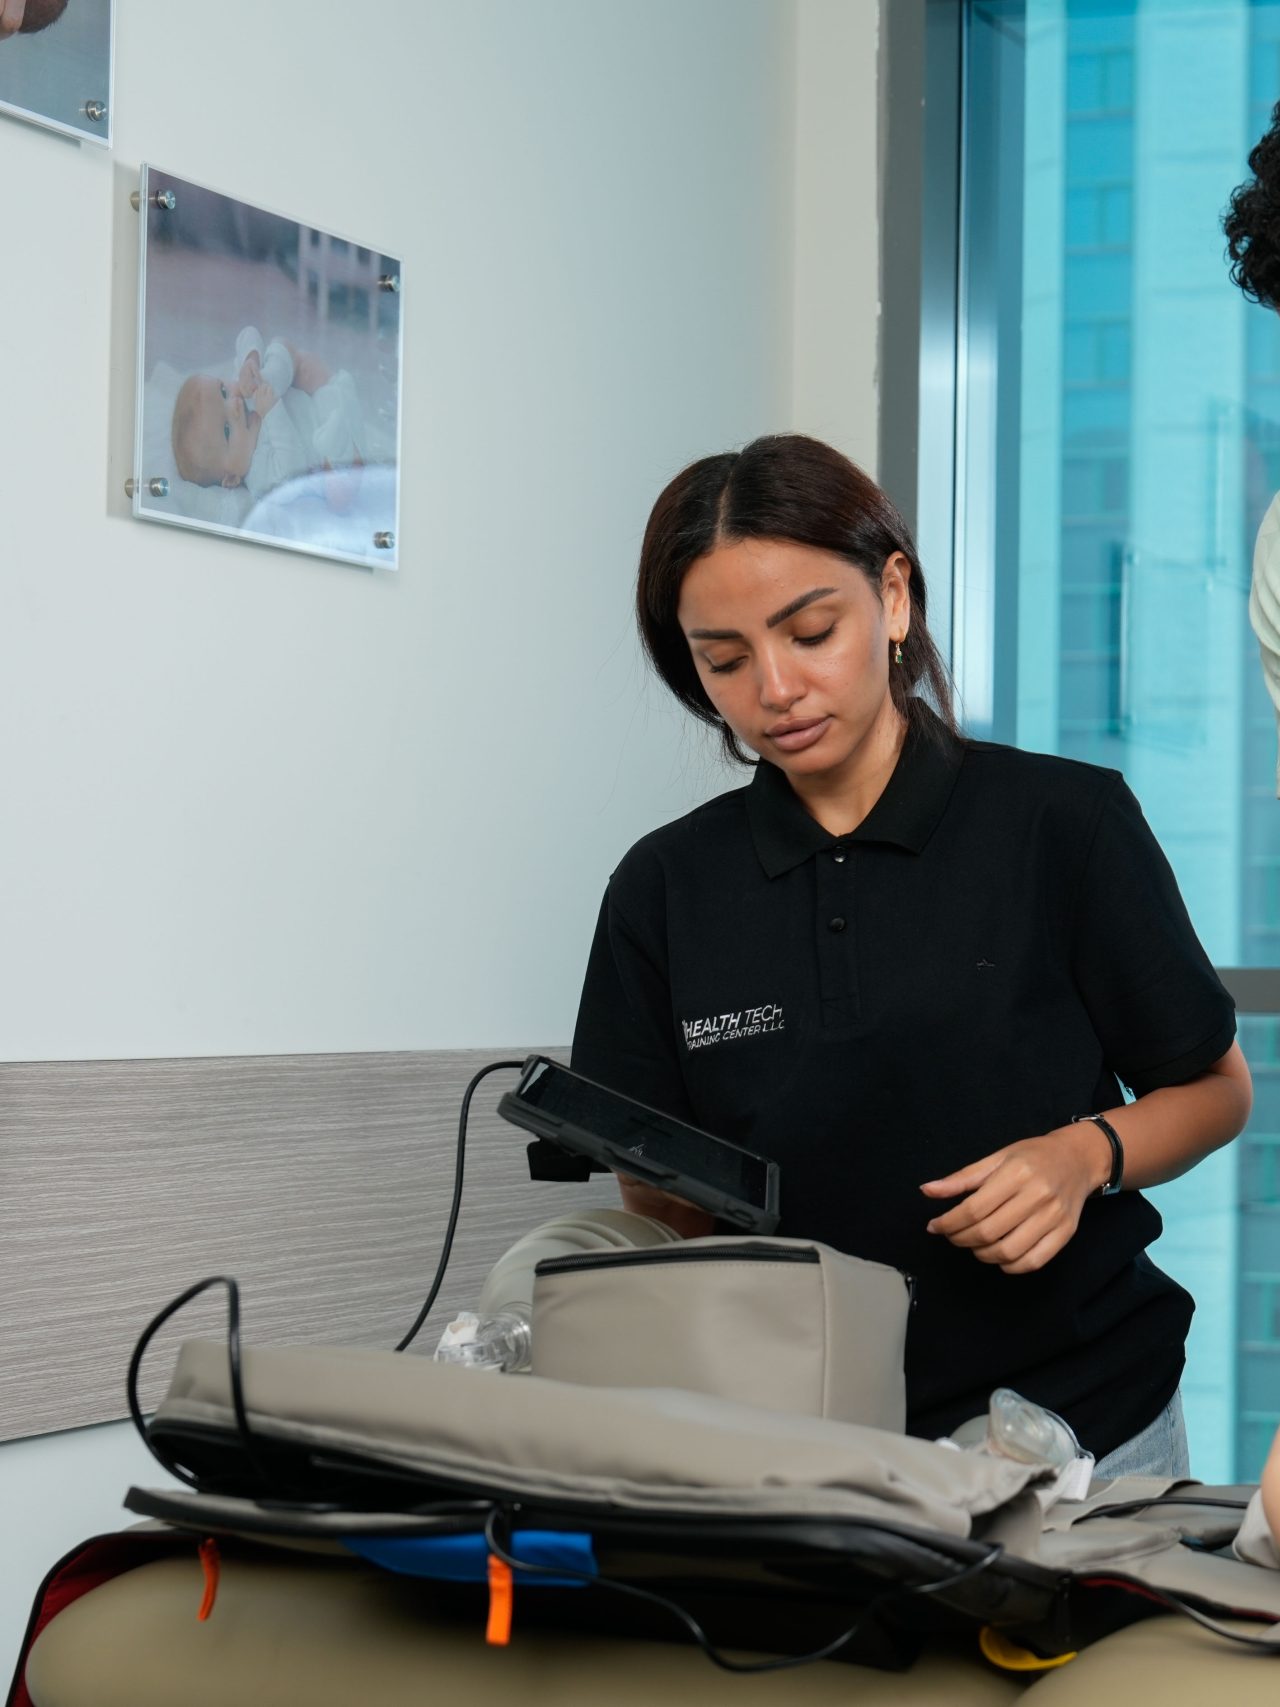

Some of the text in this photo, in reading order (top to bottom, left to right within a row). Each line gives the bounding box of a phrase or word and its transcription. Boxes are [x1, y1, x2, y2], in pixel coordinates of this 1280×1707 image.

[685, 1004, 783, 1038] HEALTH TECH
[686, 1033, 721, 1051] RAINING
[722, 1025, 761, 1040] CENTER
